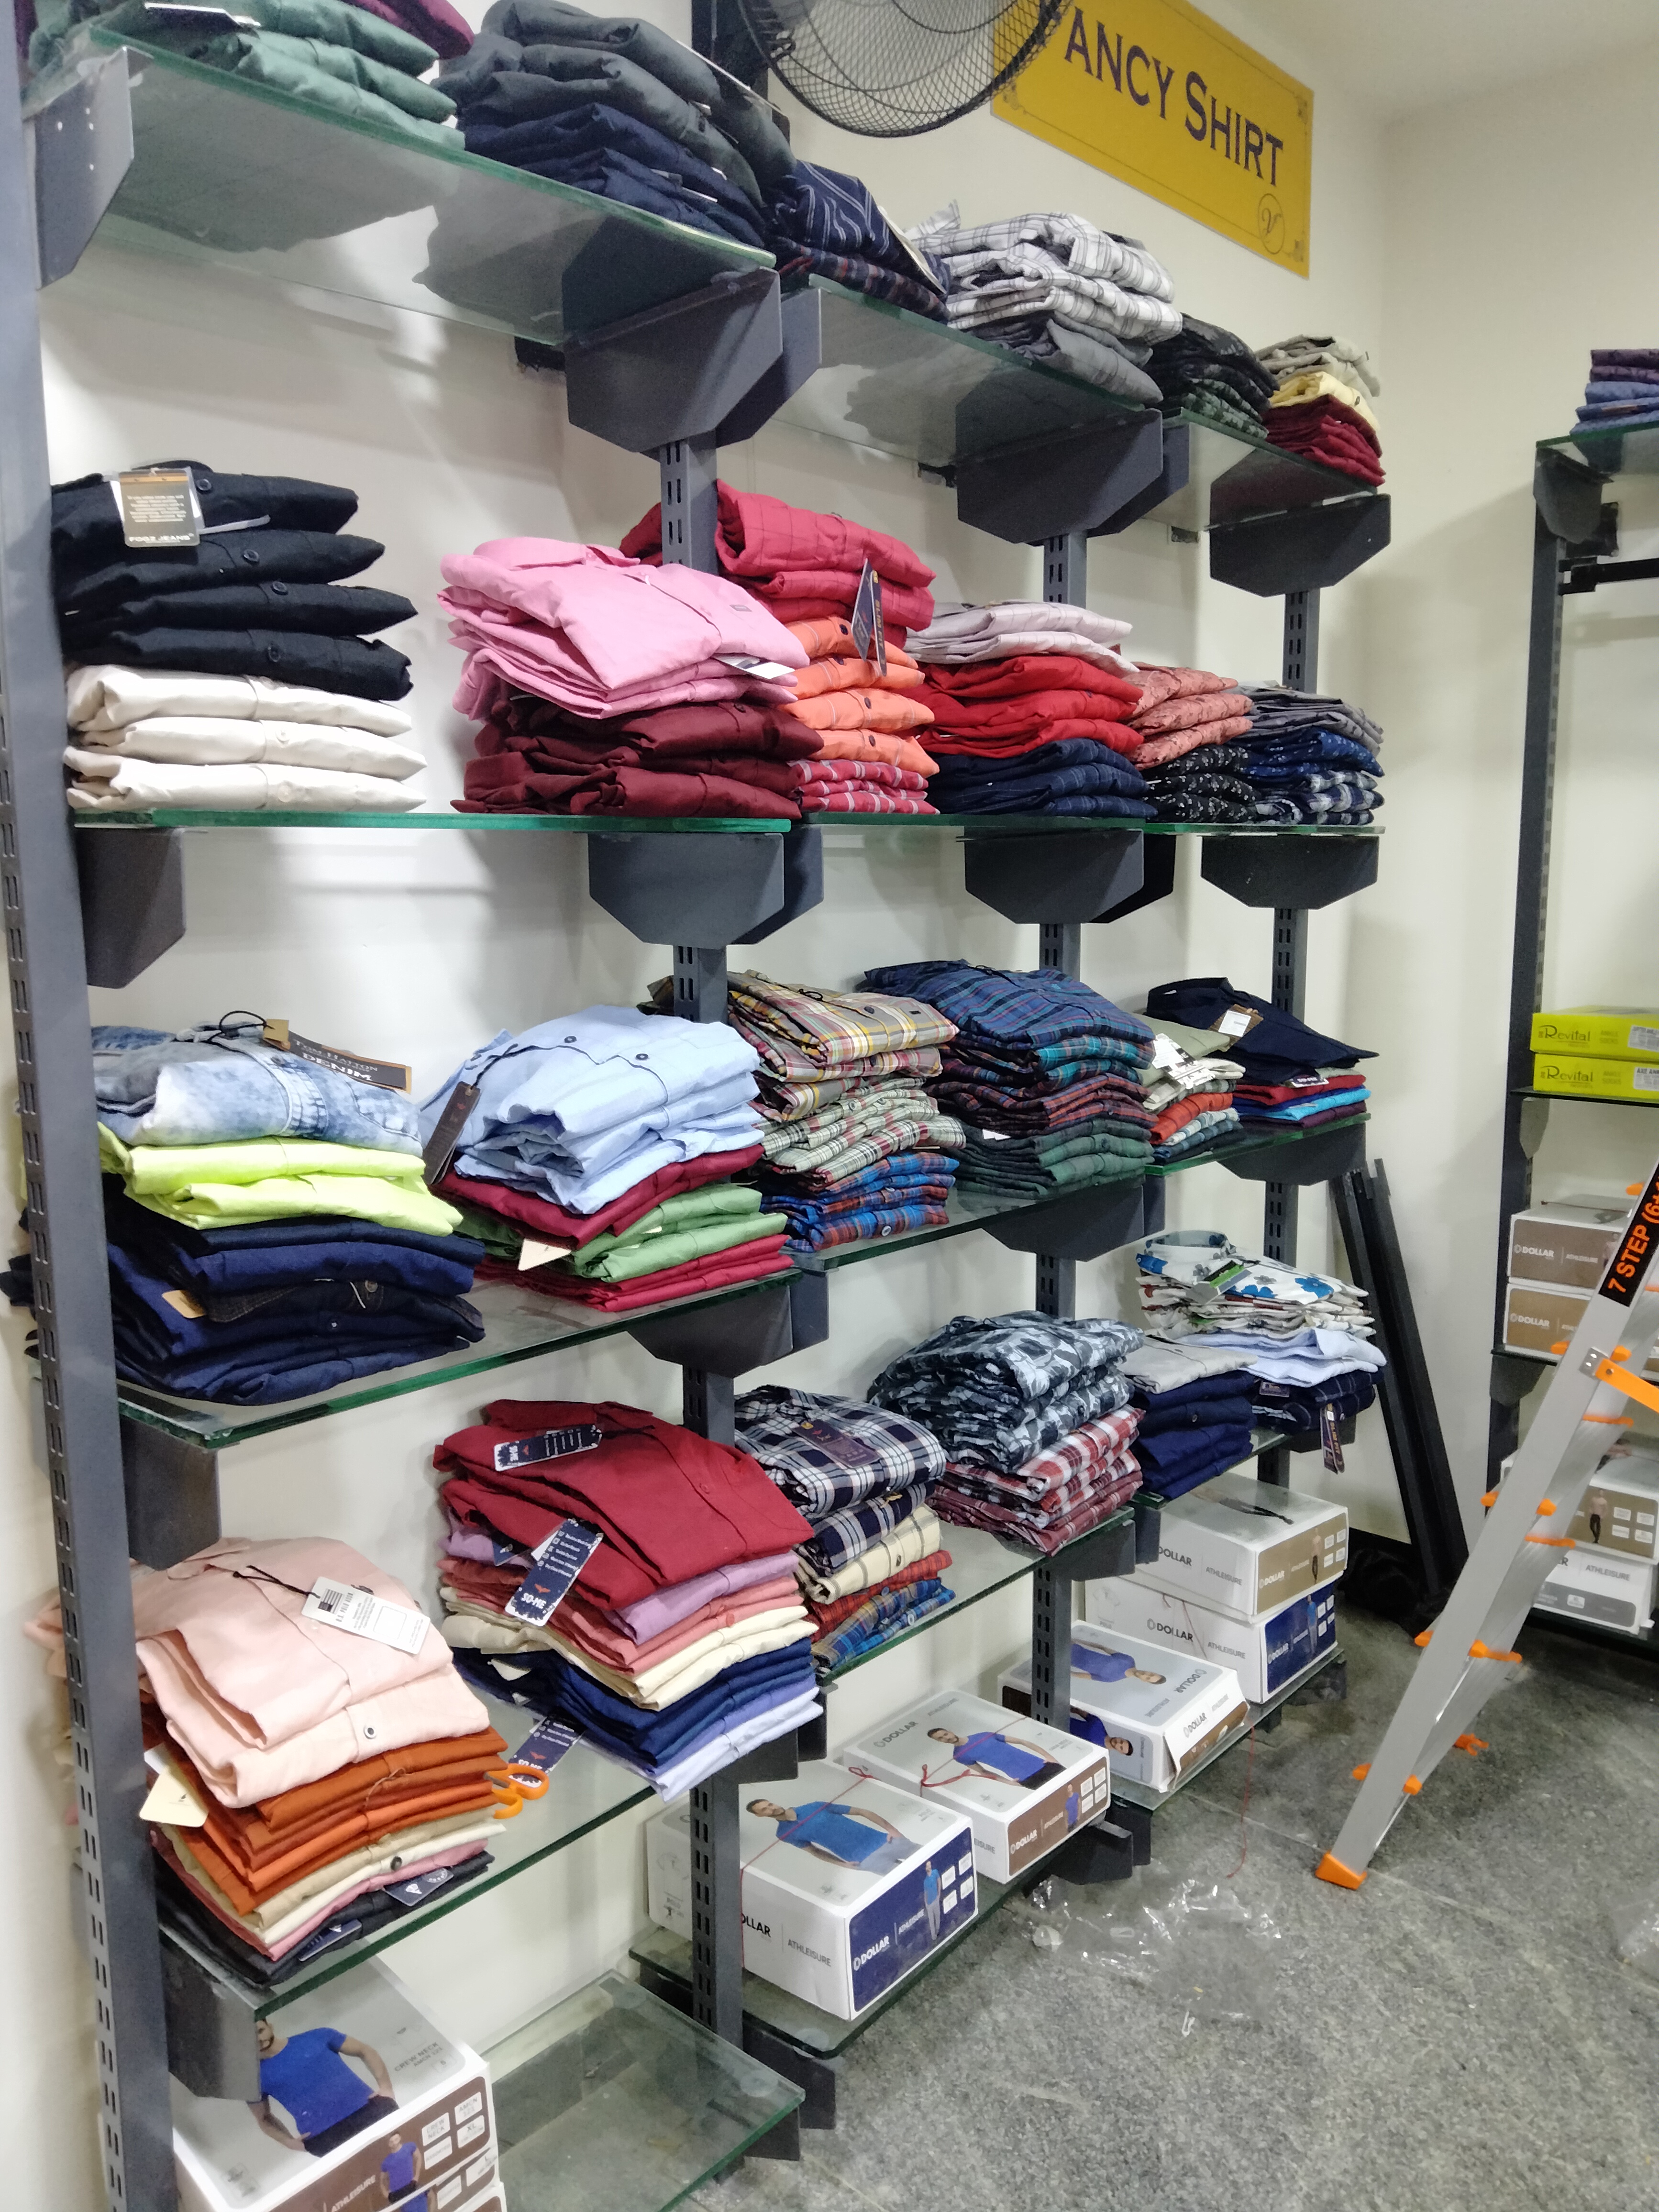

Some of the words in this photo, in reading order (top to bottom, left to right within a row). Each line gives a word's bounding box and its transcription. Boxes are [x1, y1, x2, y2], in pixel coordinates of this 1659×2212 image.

[1048, 0, 1175, 120] ANCY
[1184, 71, 1284, 187] SHIRT
[1539, 1025, 1591, 1042] Revital
[302, 1052, 373, 1081] DENIM
[1540, 1065, 1593, 1082] Revital
[1522, 1246, 1554, 1257] DOLLAR
[1616, 1224, 1650, 1278] STEP
[1607, 1278, 1627, 1293] 7
[1517, 1315, 1550, 1327] DOLLAR
[1205, 1566, 1242, 1586] ATHLEISURE
[1585, 1564, 1631, 1582] ATHLEISURE
[1156, 1622, 1194, 1642] DOLLAR
[1207, 1641, 1246, 1659] ATHLEISURE
[883, 1721, 918, 1743] DOLLAR
[1188, 1712, 1207, 1733] DOLLAR
[1016, 1829, 1038, 1848] DOLLAR
[741, 1912, 772, 1938] OLLAR
[787, 1938, 831, 1967] ATHLEISURE
[861, 1936, 890, 1965] DOLLAR
[395, 2055, 417, 2071] CREW
[418, 2042, 439, 2057] NECK
[467, 2123, 476, 2132] XL
